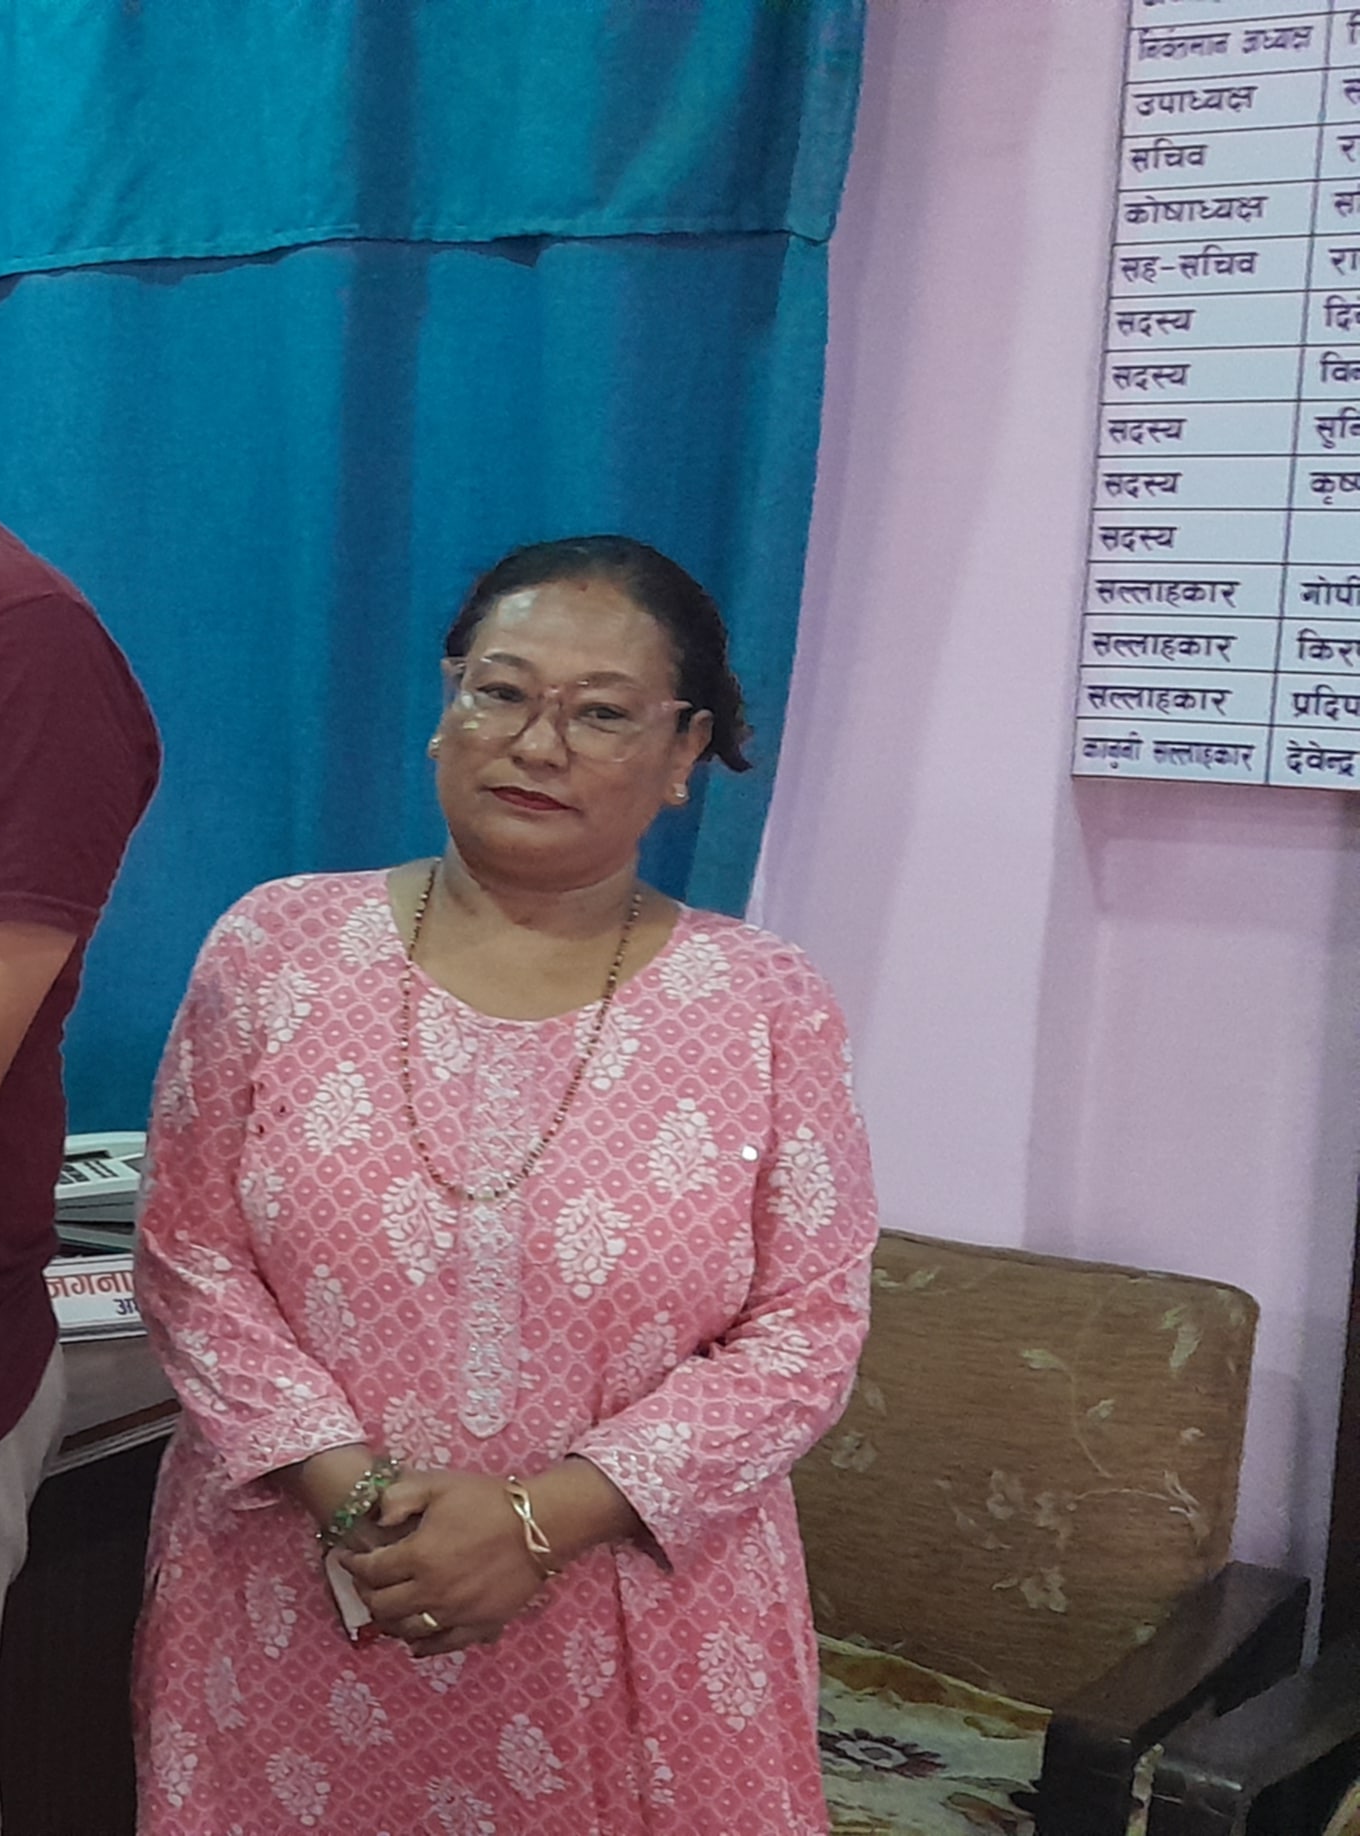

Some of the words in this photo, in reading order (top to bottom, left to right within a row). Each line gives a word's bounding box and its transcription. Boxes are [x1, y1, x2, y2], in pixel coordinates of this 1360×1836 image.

[1134, 86, 1257, 116] उपाध्यक्ष
[1130, 138, 1208, 172] सचिव
[1125, 196, 1269, 224] कोषाध्यक्ष
[1120, 245, 1258, 282] सह-सचिव
[1116, 309, 1196, 337] सदस्य
[1112, 364, 1191, 391] सदस्य
[1108, 418, 1187, 444] सदस्य
[1103, 473, 1182, 498] सदस्य
[1099, 526, 1177, 553] सदस्य
[1095, 579, 1240, 608] सल्लाहकार
[1092, 632, 1238, 662] सल्लाहकार
[1087, 685, 1232, 716] सल्लाहकार
